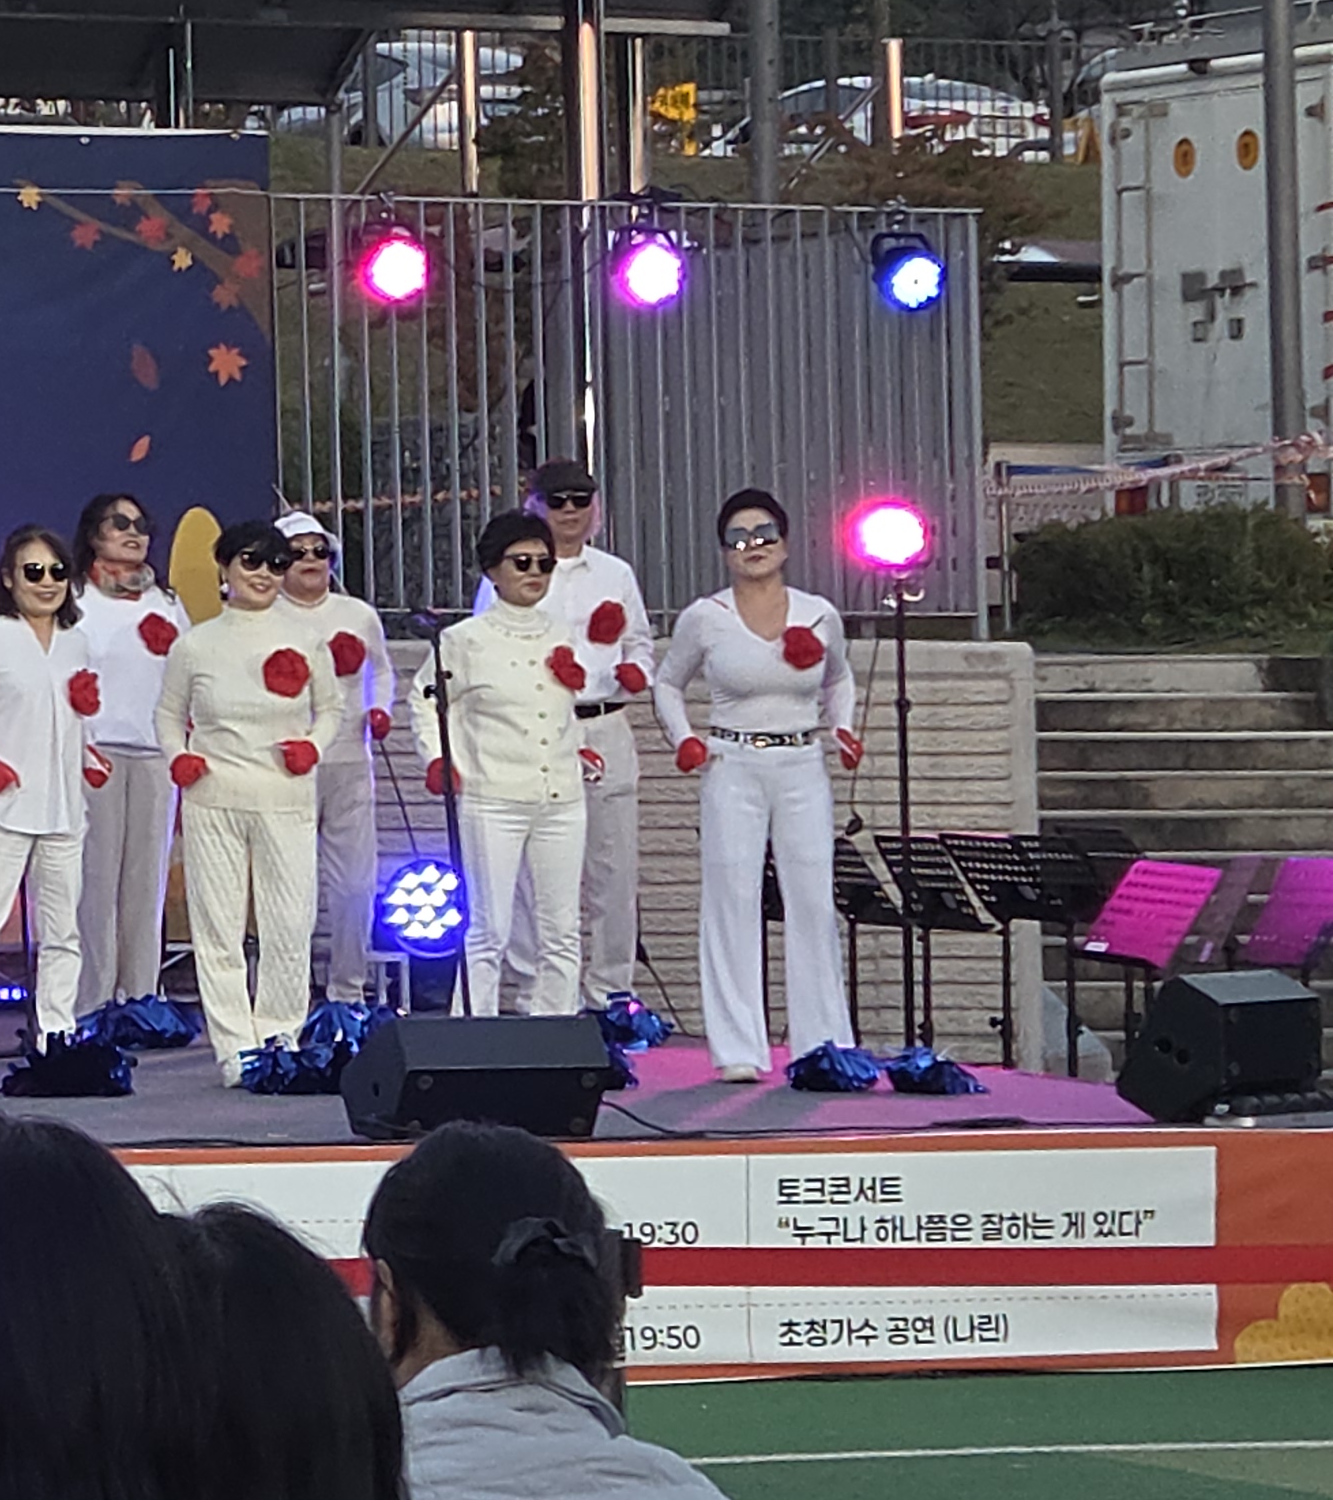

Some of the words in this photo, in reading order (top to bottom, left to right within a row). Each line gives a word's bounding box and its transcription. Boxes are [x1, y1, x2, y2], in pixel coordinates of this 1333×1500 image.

[777, 1176, 904, 1205] 토크콘서트
[981, 1211, 1055, 1242] 잘하는
[1061, 1210, 1086, 1239] 게
[623, 1324, 701, 1351] 19:50
[779, 1317, 879, 1348] 초청가수
[886, 1316, 936, 1346] 공연
[944, 1313, 1010, 1345] (나린)
